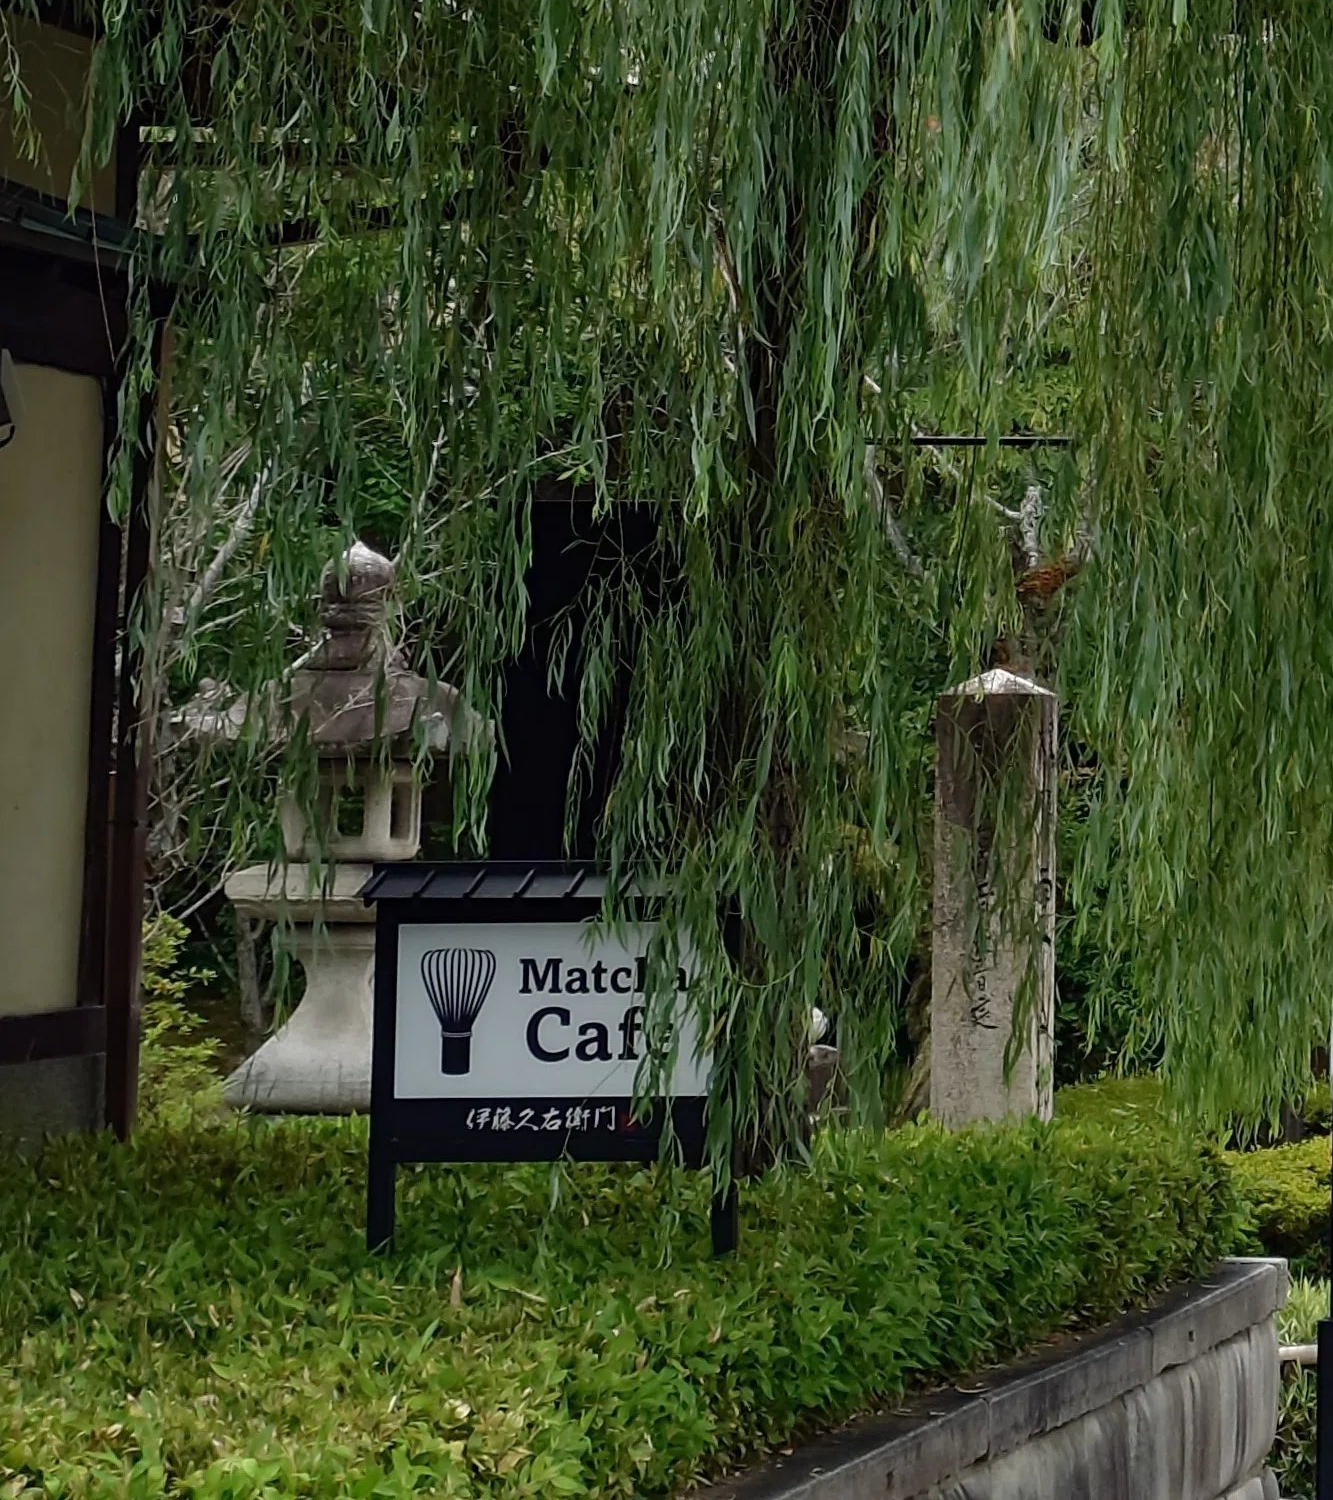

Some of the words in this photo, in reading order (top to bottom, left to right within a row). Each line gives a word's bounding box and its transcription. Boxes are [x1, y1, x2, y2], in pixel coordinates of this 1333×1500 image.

[466, 1106, 616, 1132] 伊藤久右衛門
